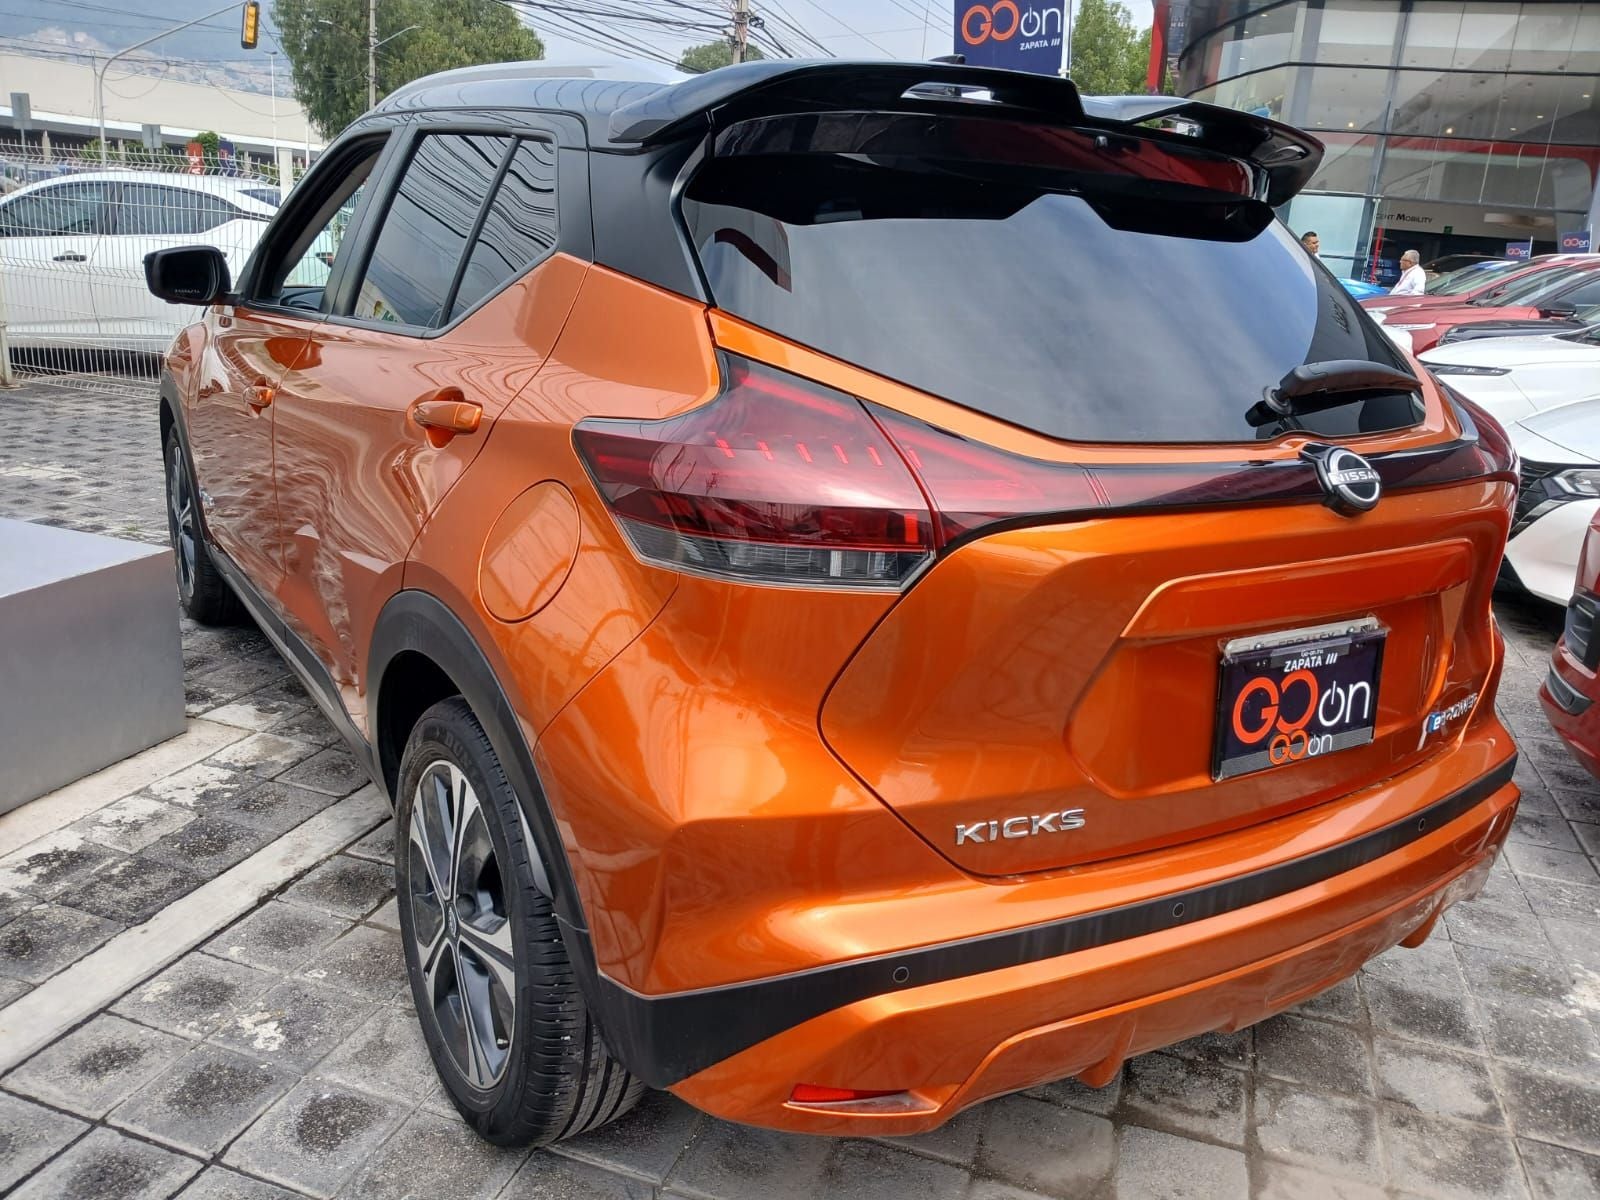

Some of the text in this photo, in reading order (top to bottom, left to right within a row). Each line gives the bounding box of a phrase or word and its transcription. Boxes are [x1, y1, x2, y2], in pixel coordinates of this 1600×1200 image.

[1020, 40, 1048, 50] ZAPATA
[1331, 471, 1381, 484] NISSAN
[1284, 656, 1323, 673] ZAPATA
[955, 808, 1086, 846] KICKS
